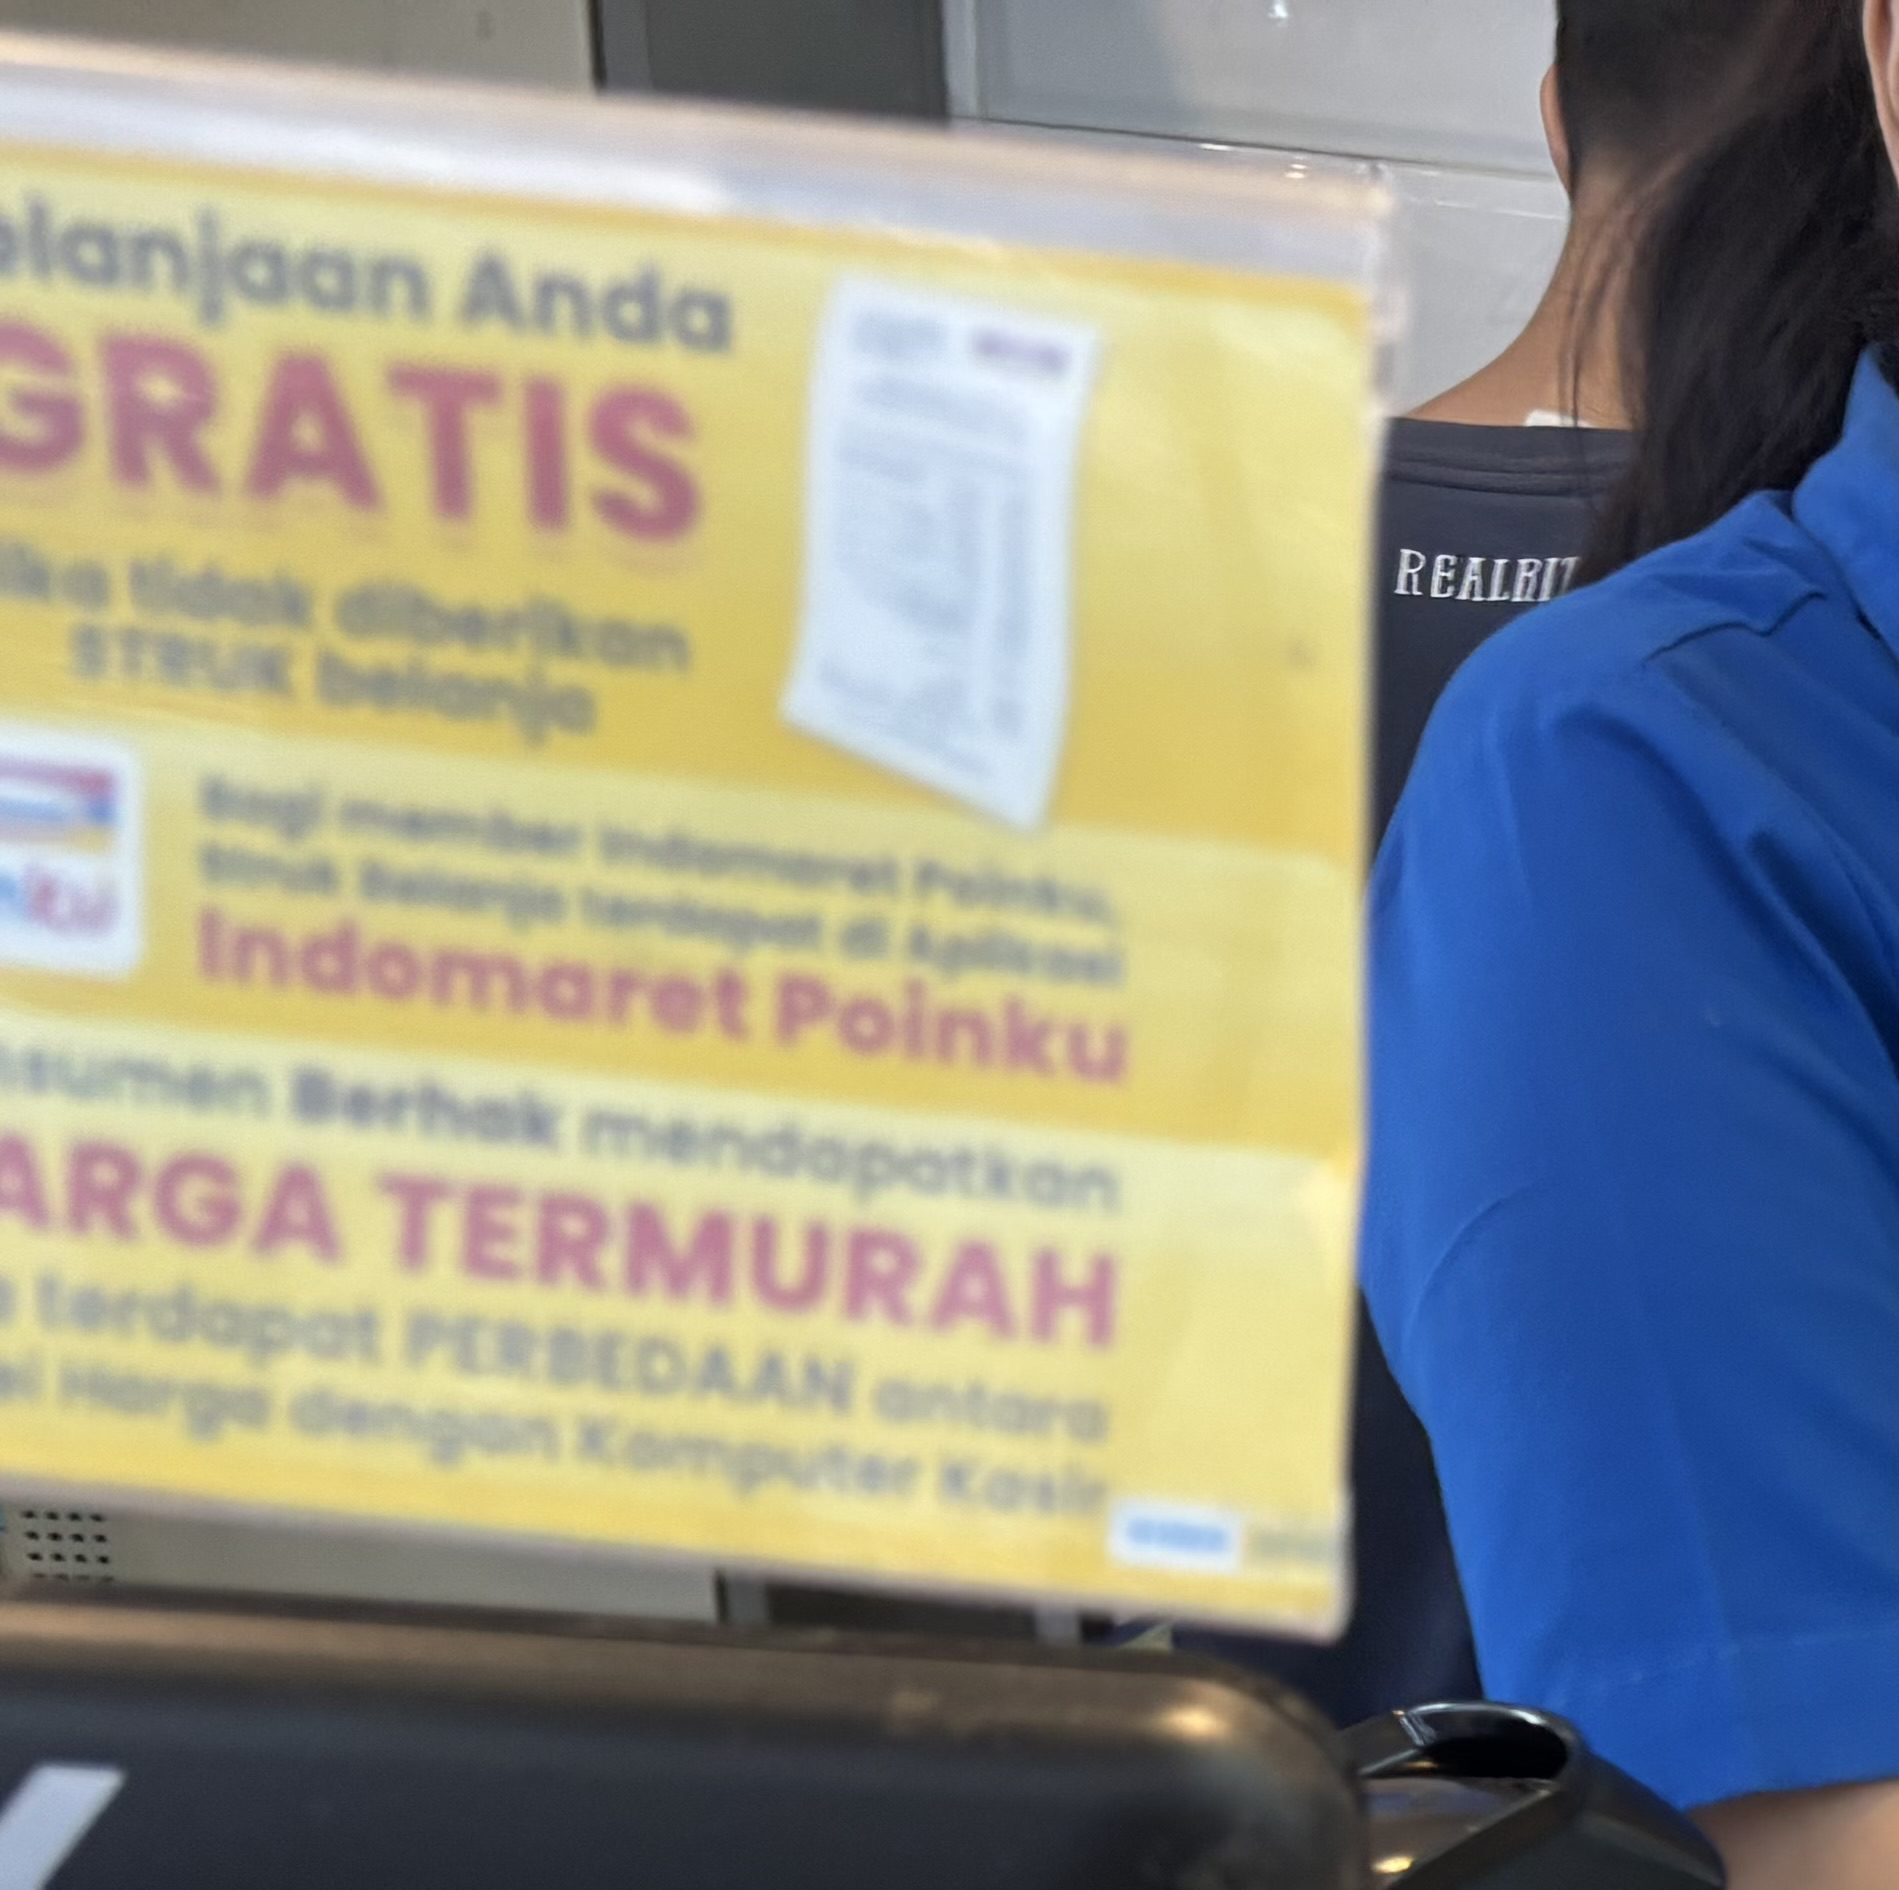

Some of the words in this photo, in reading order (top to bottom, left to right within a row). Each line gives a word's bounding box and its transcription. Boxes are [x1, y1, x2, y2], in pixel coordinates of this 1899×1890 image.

[460, 250, 735, 356] Anda
[129, 555, 314, 631] tidak
[332, 577, 693, 676] diberikan
[71, 622, 295, 697] STRUK
[315, 645, 598, 751] belanja
[337, 788, 584, 858] member
[600, 806, 902, 896] Indomaret
[197, 906, 751, 1044] Indomaret
[776, 971, 1129, 1085] Poinku
[839, 907, 888, 955] di
[290, 1063, 560, 1153] Berhak
[581, 1102, 1118, 1216] mendapatkan
[375, 1164, 1118, 1354] TERMURAH
[37, 1271, 379, 1370] terdapat
[404, 1308, 857, 1416] PERBEDAAN
[871, 1376, 1112, 1443] antara
[60, 1362, 269, 1445] Harga
[289, 1391, 560, 1470] dengan
[576, 1411, 921, 1496] Komputer
